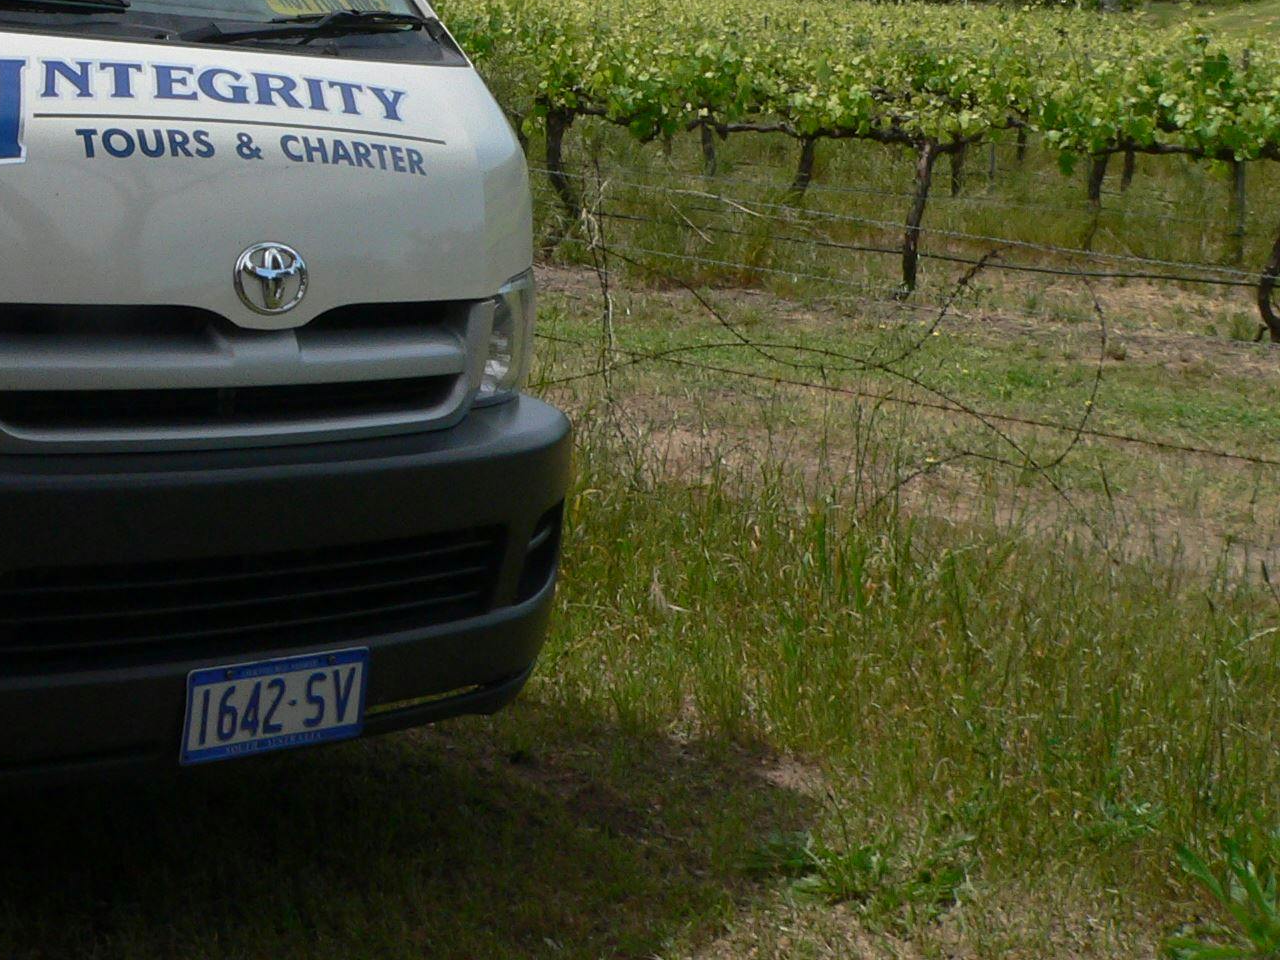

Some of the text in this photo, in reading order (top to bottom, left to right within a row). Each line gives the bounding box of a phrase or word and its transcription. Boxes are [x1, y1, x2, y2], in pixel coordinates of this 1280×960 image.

[75, 127, 426, 176] TOURS & CHARTER
